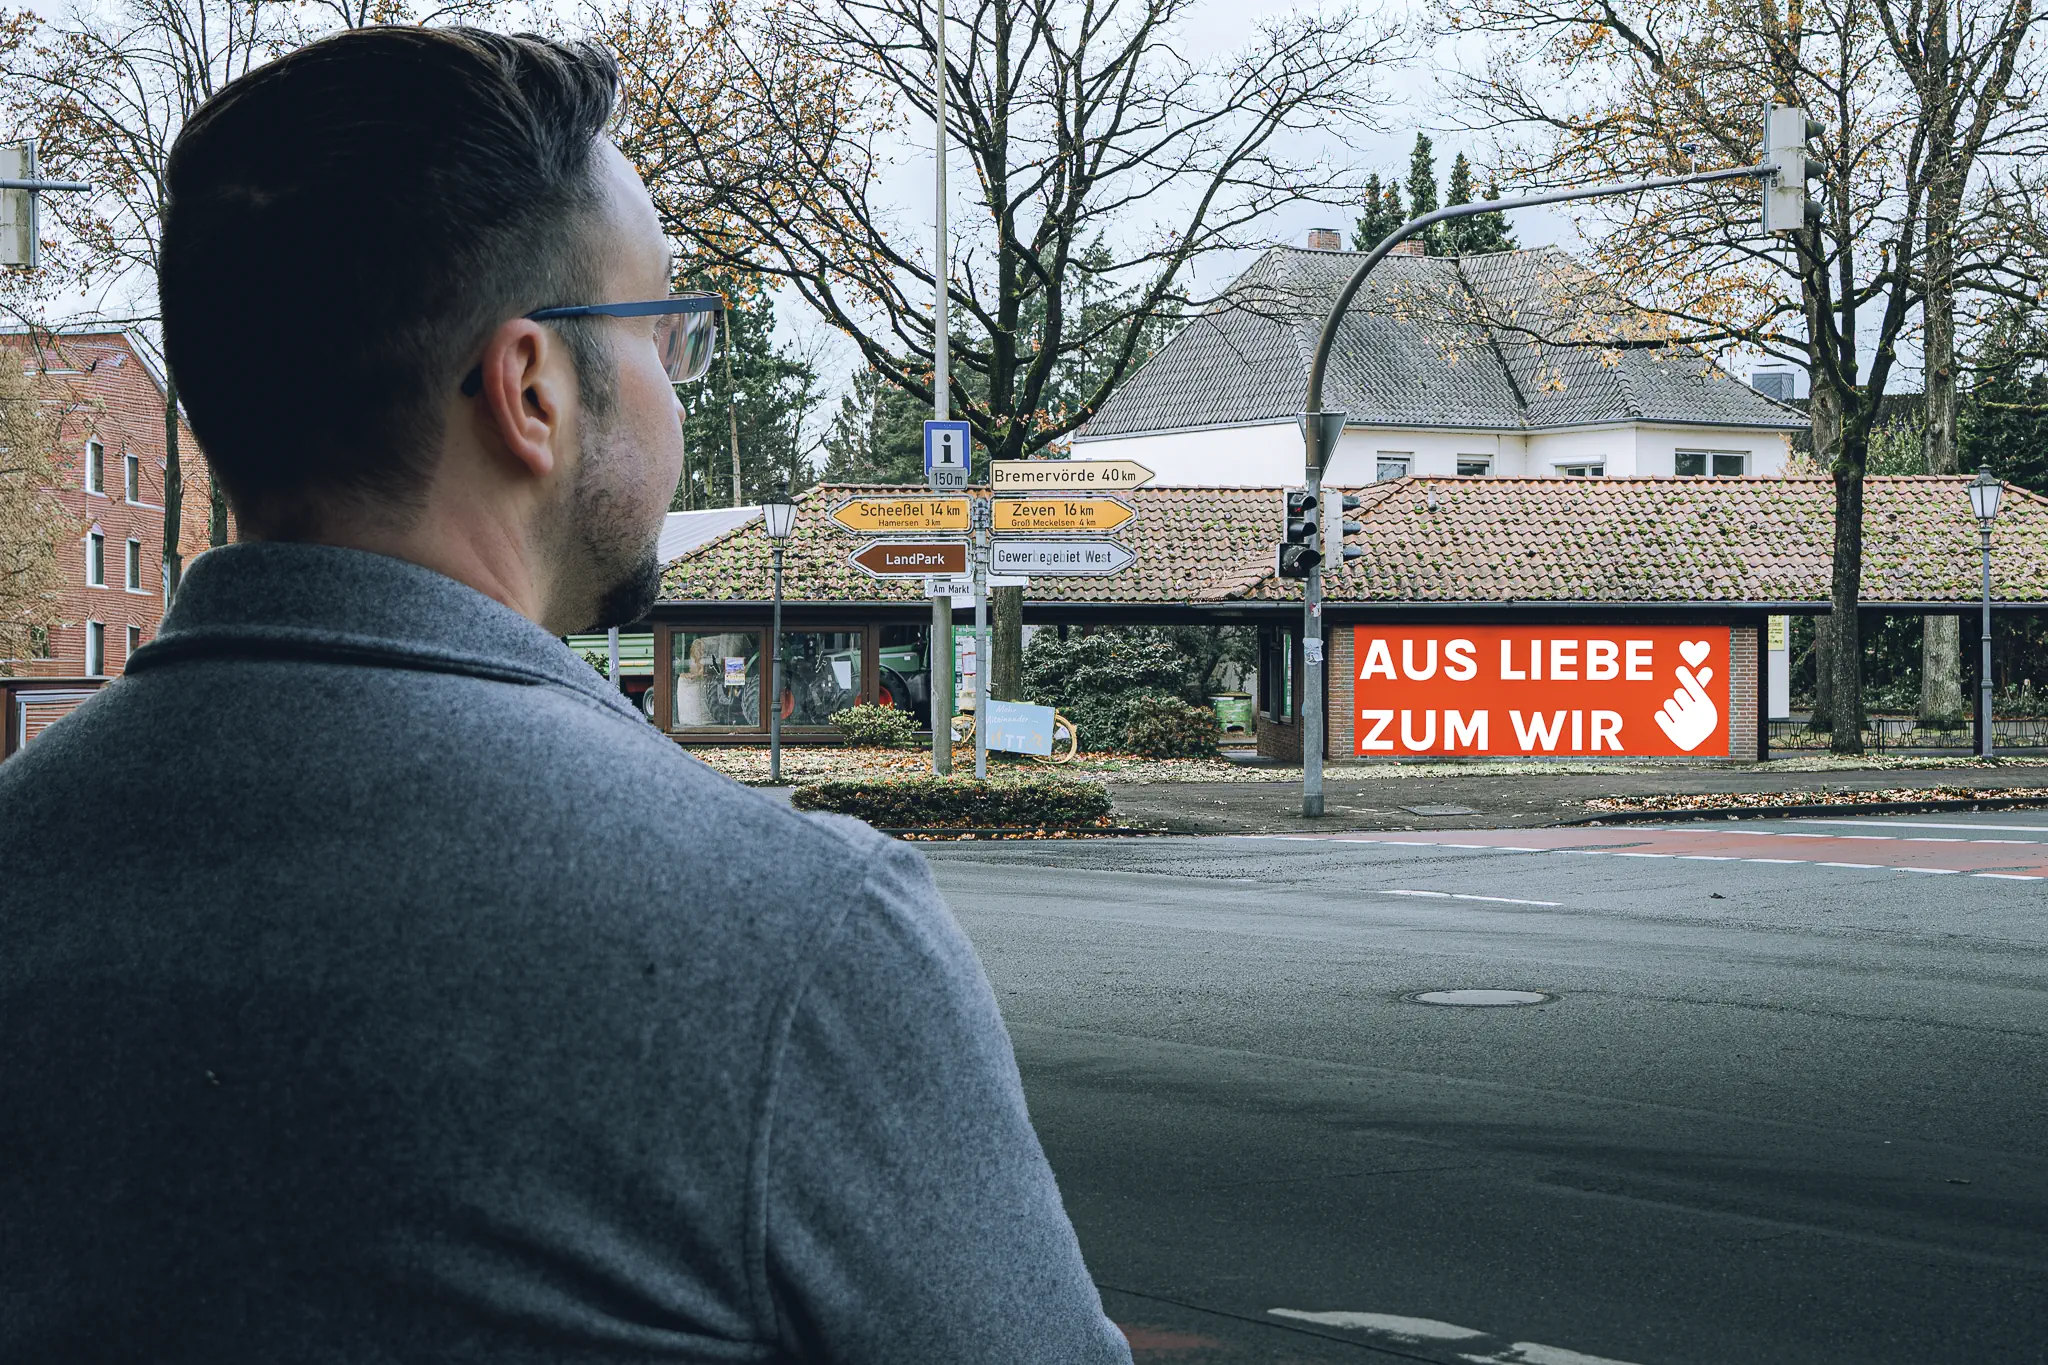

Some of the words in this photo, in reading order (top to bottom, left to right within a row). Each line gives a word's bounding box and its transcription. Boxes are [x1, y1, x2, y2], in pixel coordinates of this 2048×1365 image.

[994, 469, 1095, 482] Bremervörde
[1101, 468, 1119, 482] 40
[1122, 470, 1136, 481] km
[860, 503, 924, 517] Scheeßel
[930, 503, 943, 516] 14
[947, 504, 960, 516] km
[1012, 503, 1055, 516] Zeven
[1064, 503, 1077, 516] 16
[1080, 504, 1094, 516] km
[878, 519, 919, 527] Hamersen
[925, 519, 930, 527] 3
[1011, 519, 1030, 527] Groß
[1033, 519, 1075, 527] Meckelsen
[886, 553, 945, 565] LandPark
[998, 550, 1081, 565] Gewerbegebiet
[1085, 550, 1112, 563] West
[933, 585, 945, 593] Am
[948, 584, 970, 593] Markt
[1359, 638, 1478, 682] AUS
[1500, 639, 1654, 681] LIEBE
[1361, 709, 1489, 752] ZUM
[1508, 710, 1625, 751] WIR
